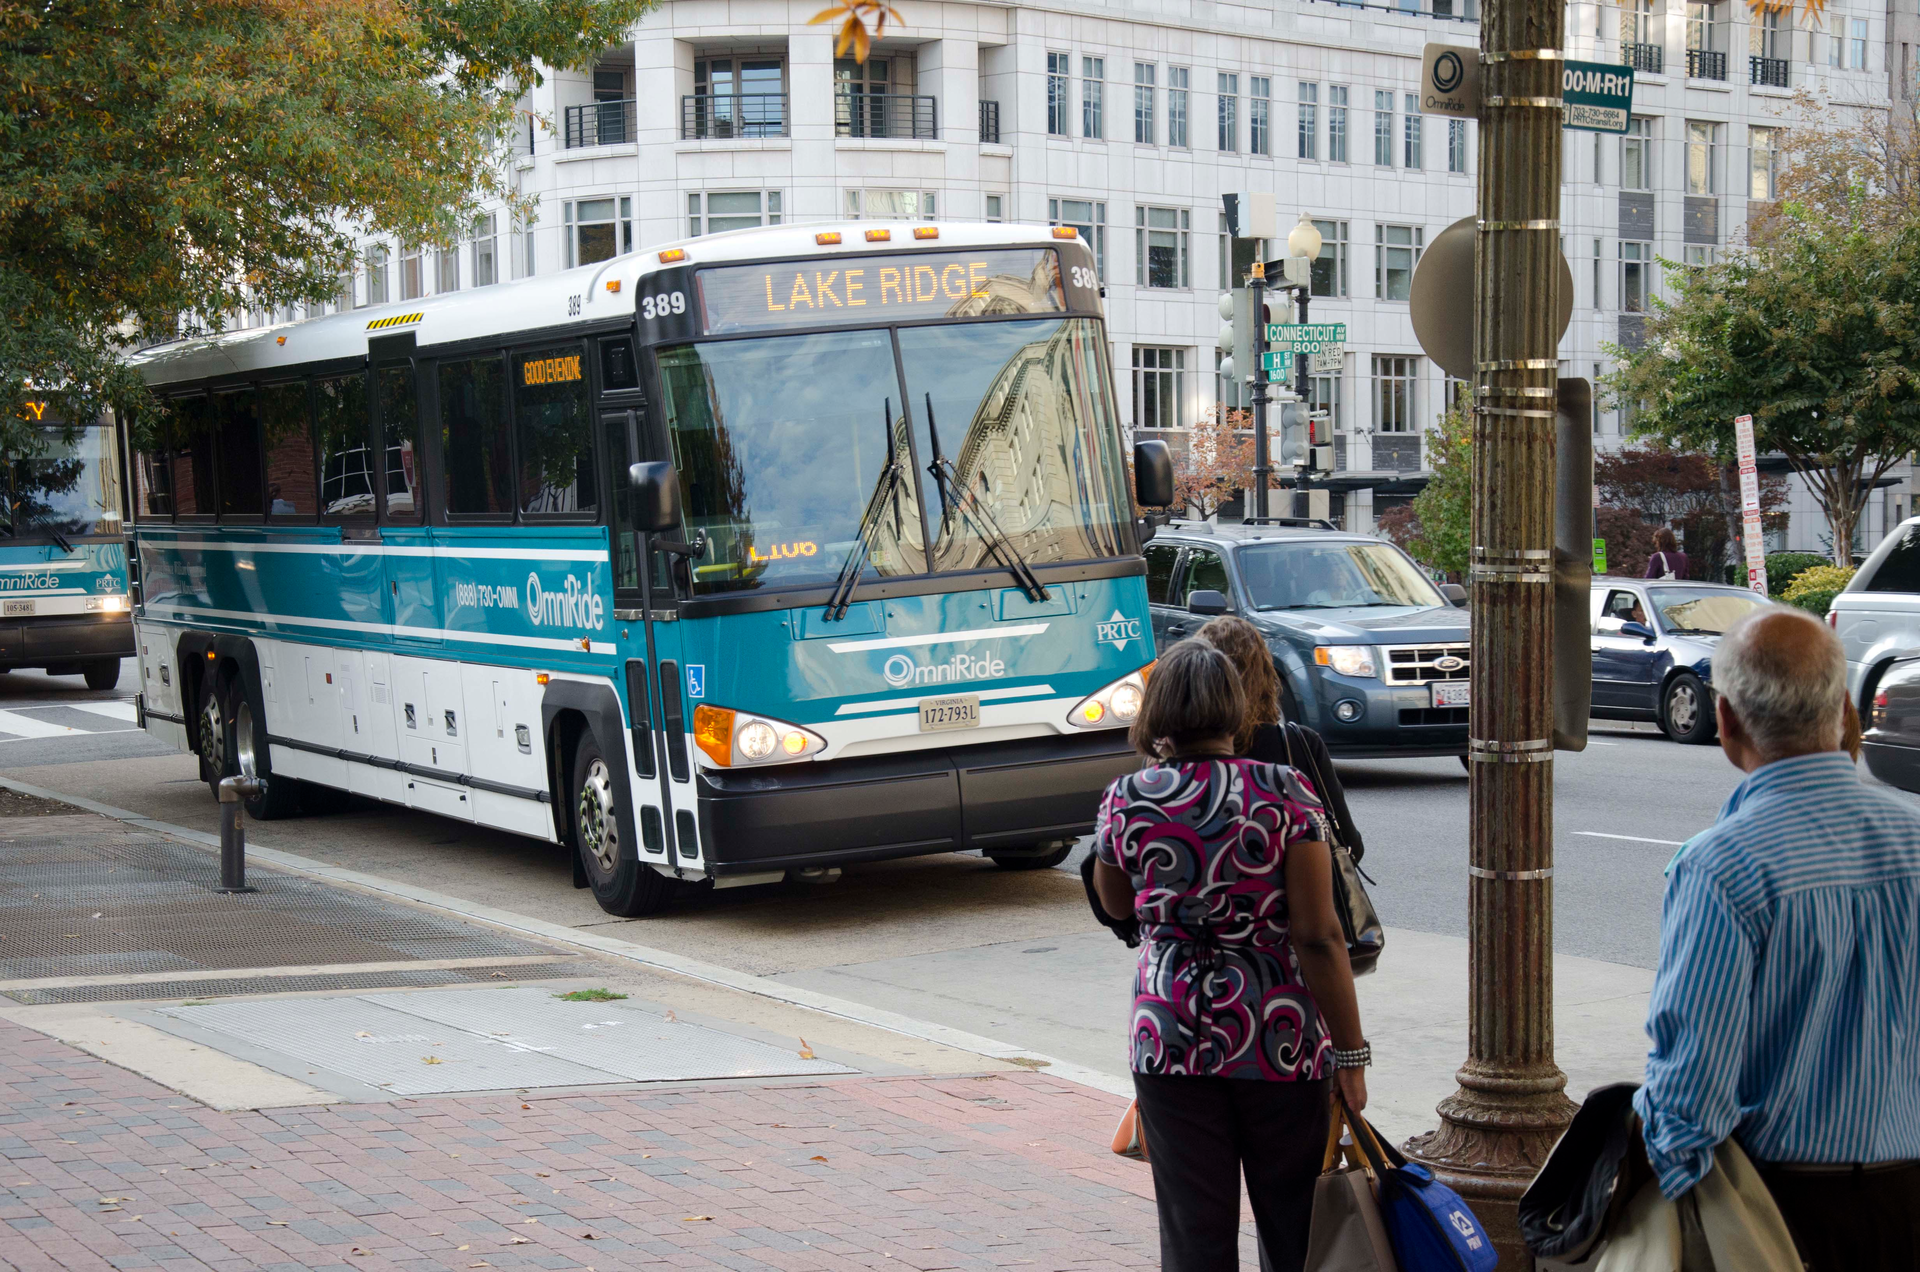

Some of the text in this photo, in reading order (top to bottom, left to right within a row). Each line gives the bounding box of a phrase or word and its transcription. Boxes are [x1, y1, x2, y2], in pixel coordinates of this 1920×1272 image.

[1425, 96, 1465, 111] OmniRide
[1573, 106, 1620, 119] 703-730-6664
[1573, 114, 1623, 129] PRTCtransit.org
[1071, 266, 1099, 290] 389
[764, 262, 990, 311] LAKE RIDGE
[568, 294, 581, 317] 389
[642, 291, 686, 320] 389
[1269, 326, 1335, 341] CONNECTICUT
[1293, 342, 1320, 353] 800
[1328, 347, 1341, 357] RED
[1273, 353, 1281, 368] H
[1316, 358, 1342, 369] 7AM-7PM
[524, 360, 546, 385] GOOD
[1270, 370, 1285, 380] 1600
[96, 578, 121, 588] PRTC
[456, 581, 519, 609] (888) 730-OMNI
[527, 571, 604, 630] OmniRide
[1097, 620, 1141, 641] PRTC
[883, 651, 1005, 686] OmniRide
[935, 698, 964, 706] VIRGINIA
